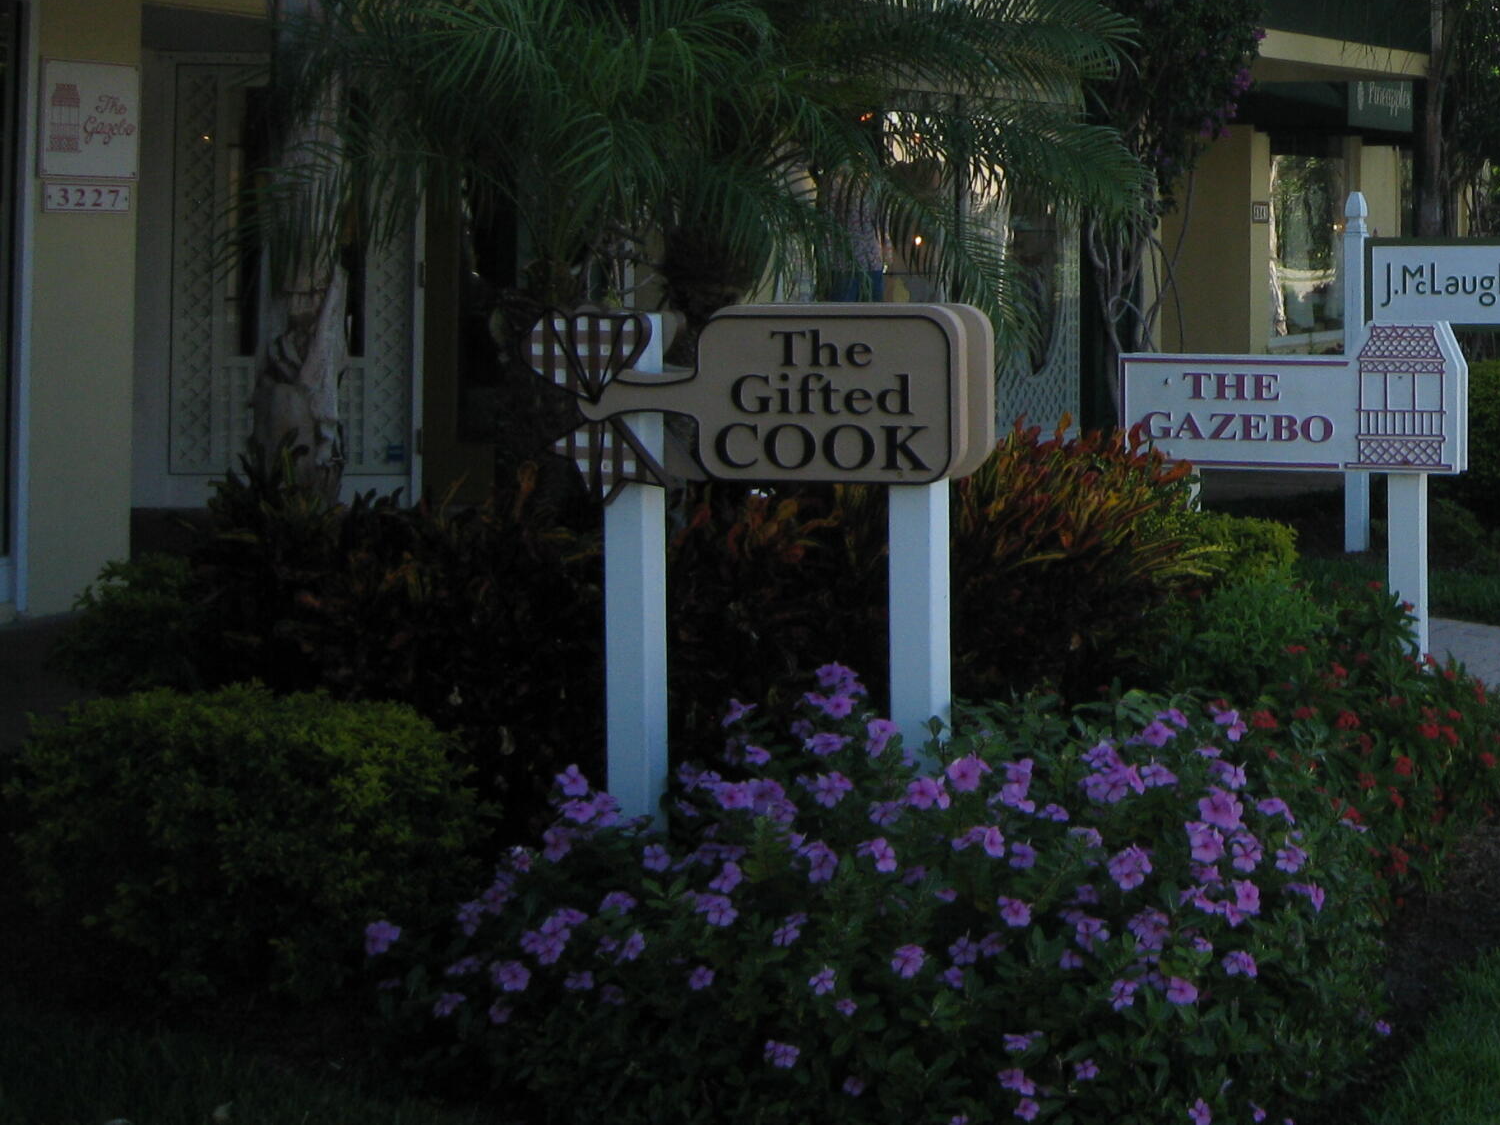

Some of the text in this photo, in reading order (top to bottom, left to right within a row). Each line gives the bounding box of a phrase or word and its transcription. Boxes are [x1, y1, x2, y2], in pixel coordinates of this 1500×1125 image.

[95, 95, 127, 115] The
[83, 115, 136, 145] Gazebo
[56, 187, 120, 207] 3227
[770, 329, 873, 368] The
[730, 373, 914, 415] Gifted
[1183, 372, 1281, 402] THE
[1142, 410, 1334, 443] GAZEBO
[714, 423, 932, 473] COOK
